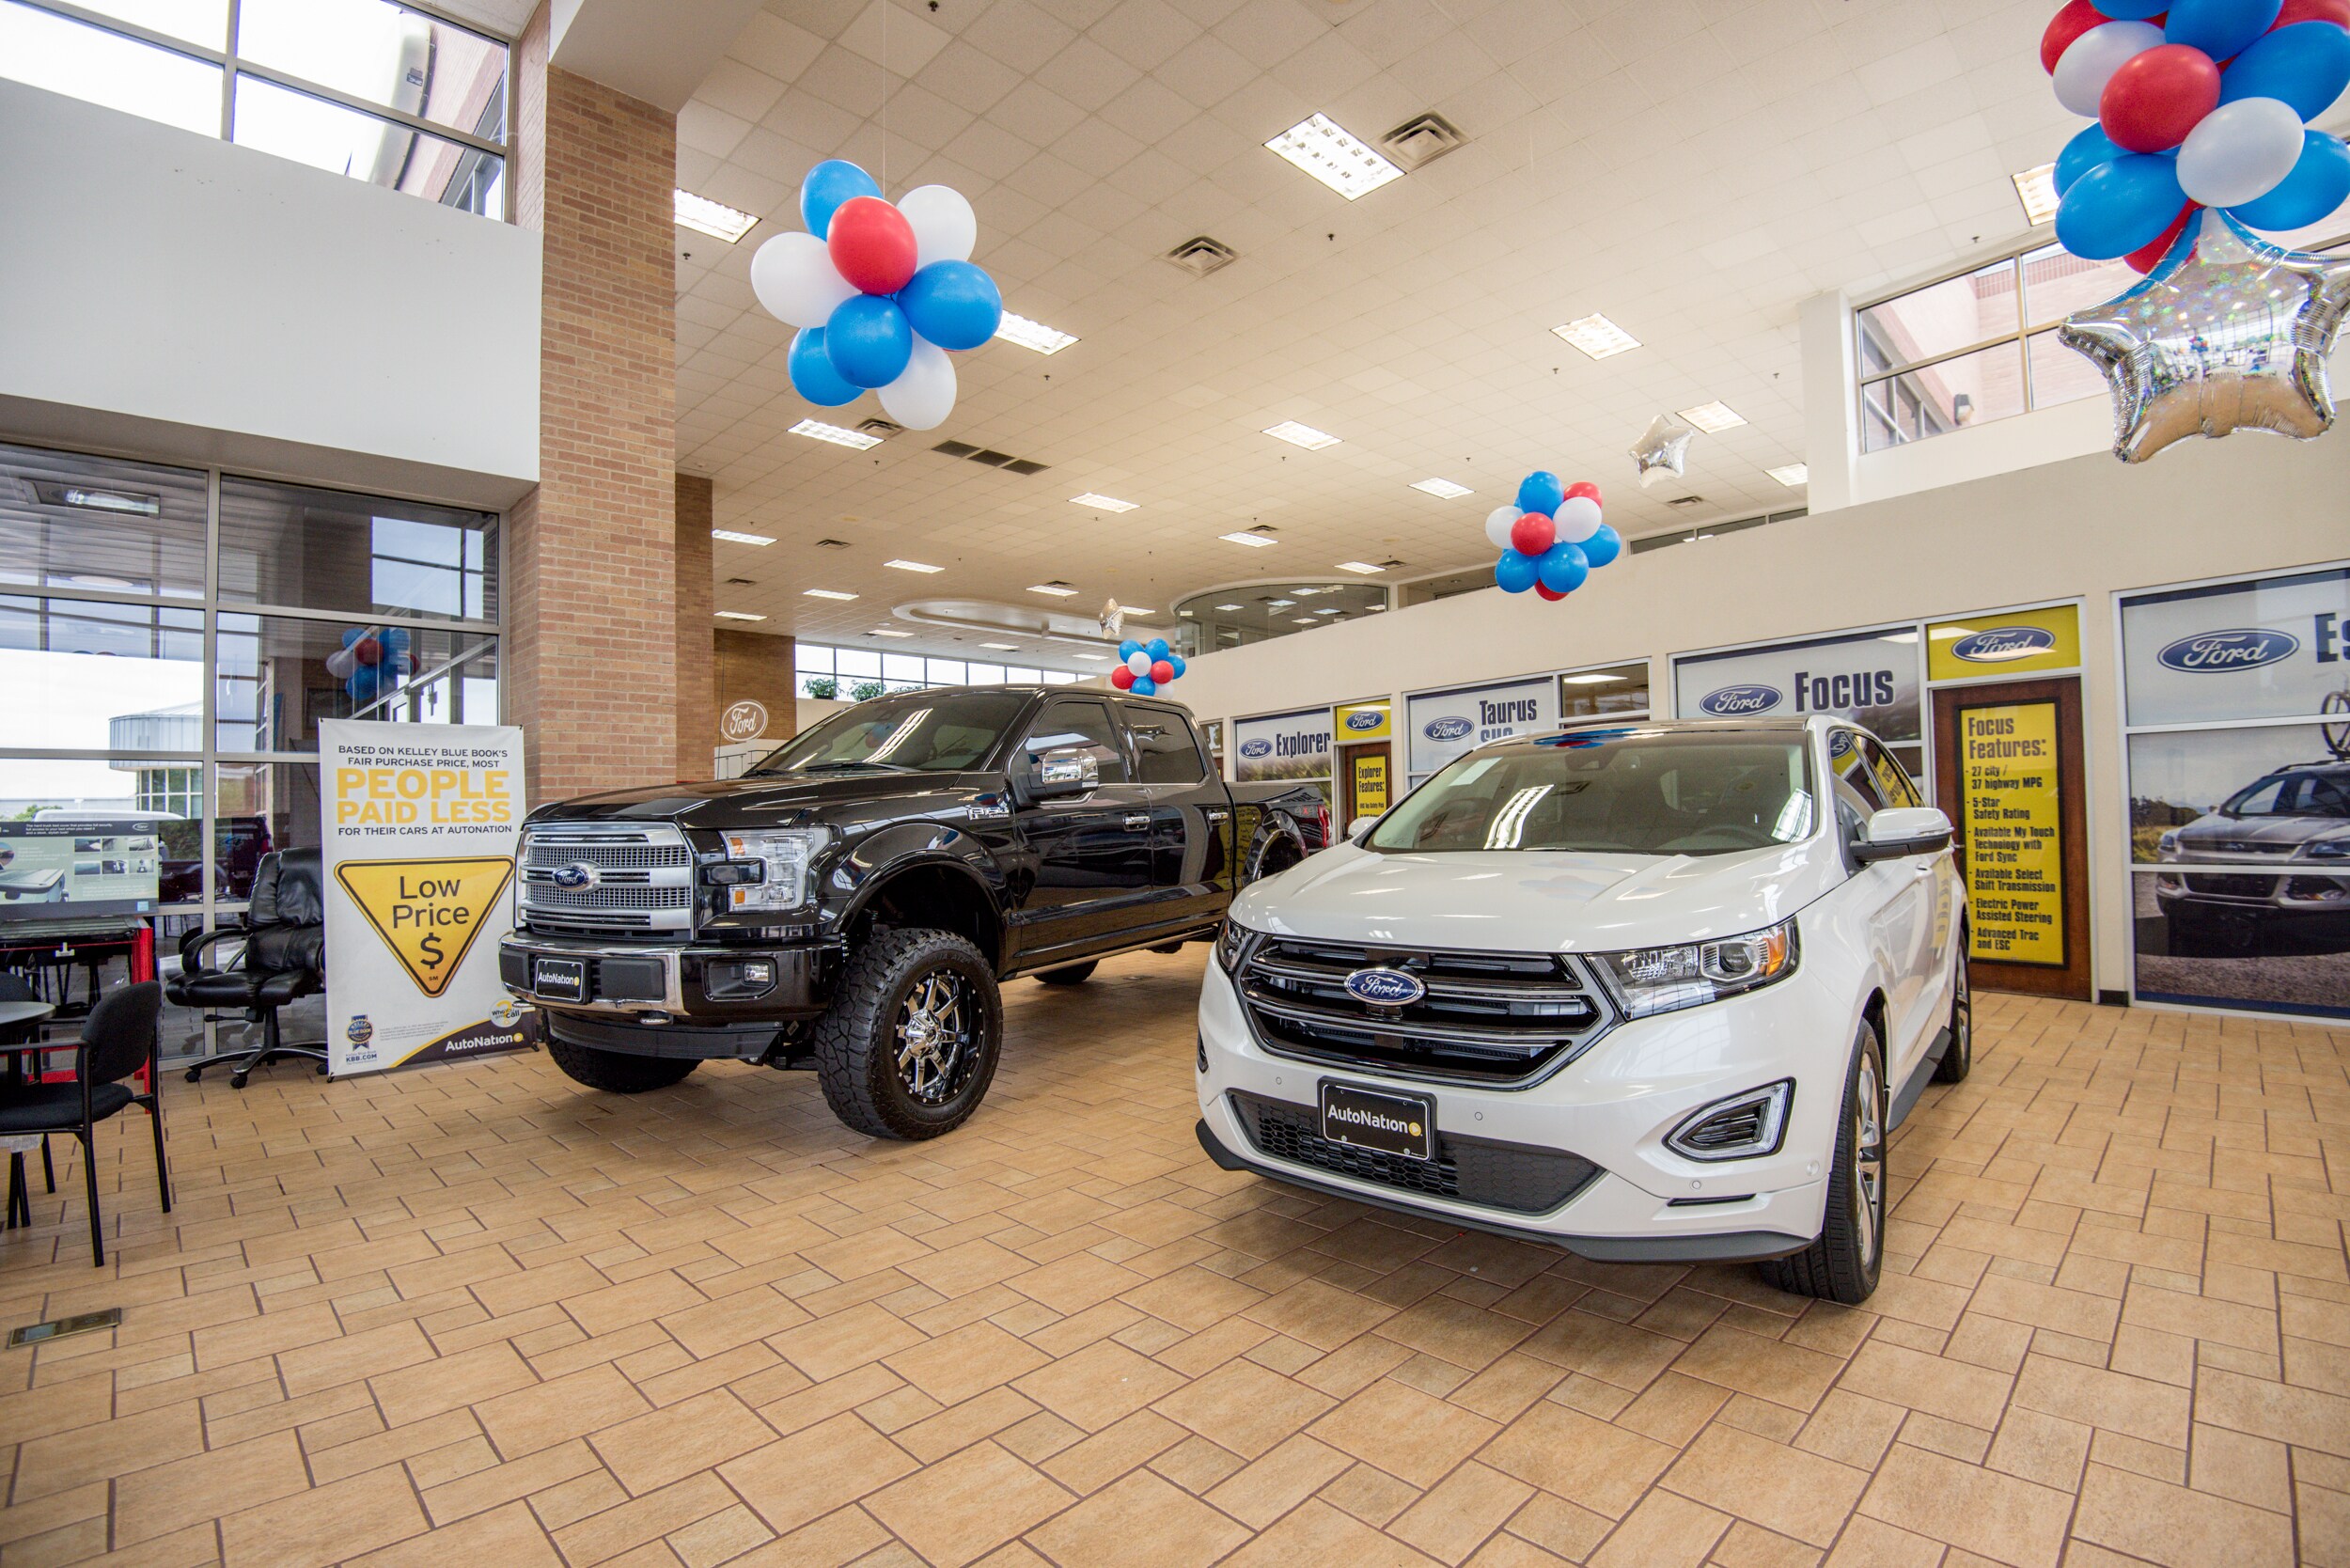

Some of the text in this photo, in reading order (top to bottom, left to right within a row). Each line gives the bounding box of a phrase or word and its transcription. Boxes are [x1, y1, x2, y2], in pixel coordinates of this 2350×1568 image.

[1971, 632, 2033, 655] Ford
[2184, 636, 2269, 666] Ford
[1715, 670, 1895, 712] Ford Focus
[729, 707, 757, 734] Ford
[1433, 721, 1465, 738] Ford
[1480, 699, 1537, 726] Taurus
[1968, 716, 2014, 737] Focus
[338, 745, 509, 758] BASED ON KELLEY BLUE BOOK'S
[1276, 731, 1330, 759] Explorer
[1969, 738, 2047, 760] Features:
[348, 757, 500, 769] FAIR PURCHASE PRICE, MOST
[1358, 765, 1383, 780] Explorer
[1972, 765, 1982, 777] 27
[1984, 765, 2000, 777] city
[337, 767, 510, 800] PEOPLE
[1358, 780, 1385, 793] Features:
[1971, 776, 2044, 791] 37 highway MPG
[1972, 796, 2000, 808] 5-Star
[337, 801, 511, 824] PAID LESS
[1973, 808, 2030, 821] Safety Rating
[338, 825, 512, 836] FOR THEIR CARS AT AUTONATION
[1974, 826, 2055, 839] Available My Touch
[1974, 839, 2042, 851] Technology with
[1975, 851, 2017, 864] Ford Sync
[1975, 869, 2043, 881] Available Select
[400, 875, 462, 900] Low
[1974, 879, 2056, 893] Shift Transmission
[1976, 898, 2039, 911] Electric Power
[392, 902, 470, 929] Price
[1976, 910, 2053, 925] Assisted Steering
[1977, 927, 2040, 941] Advanced Trac
[419, 933, 445, 970] $
[1977, 939, 2011, 950] and ESC
[538, 971, 574, 986] AutoNation
[506, 1010, 520, 1018] call
[445, 1033, 513, 1053] AutoNation
[346, 1053, 378, 1063] KBB.COM
[1327, 1104, 1408, 1134] AutoNation
